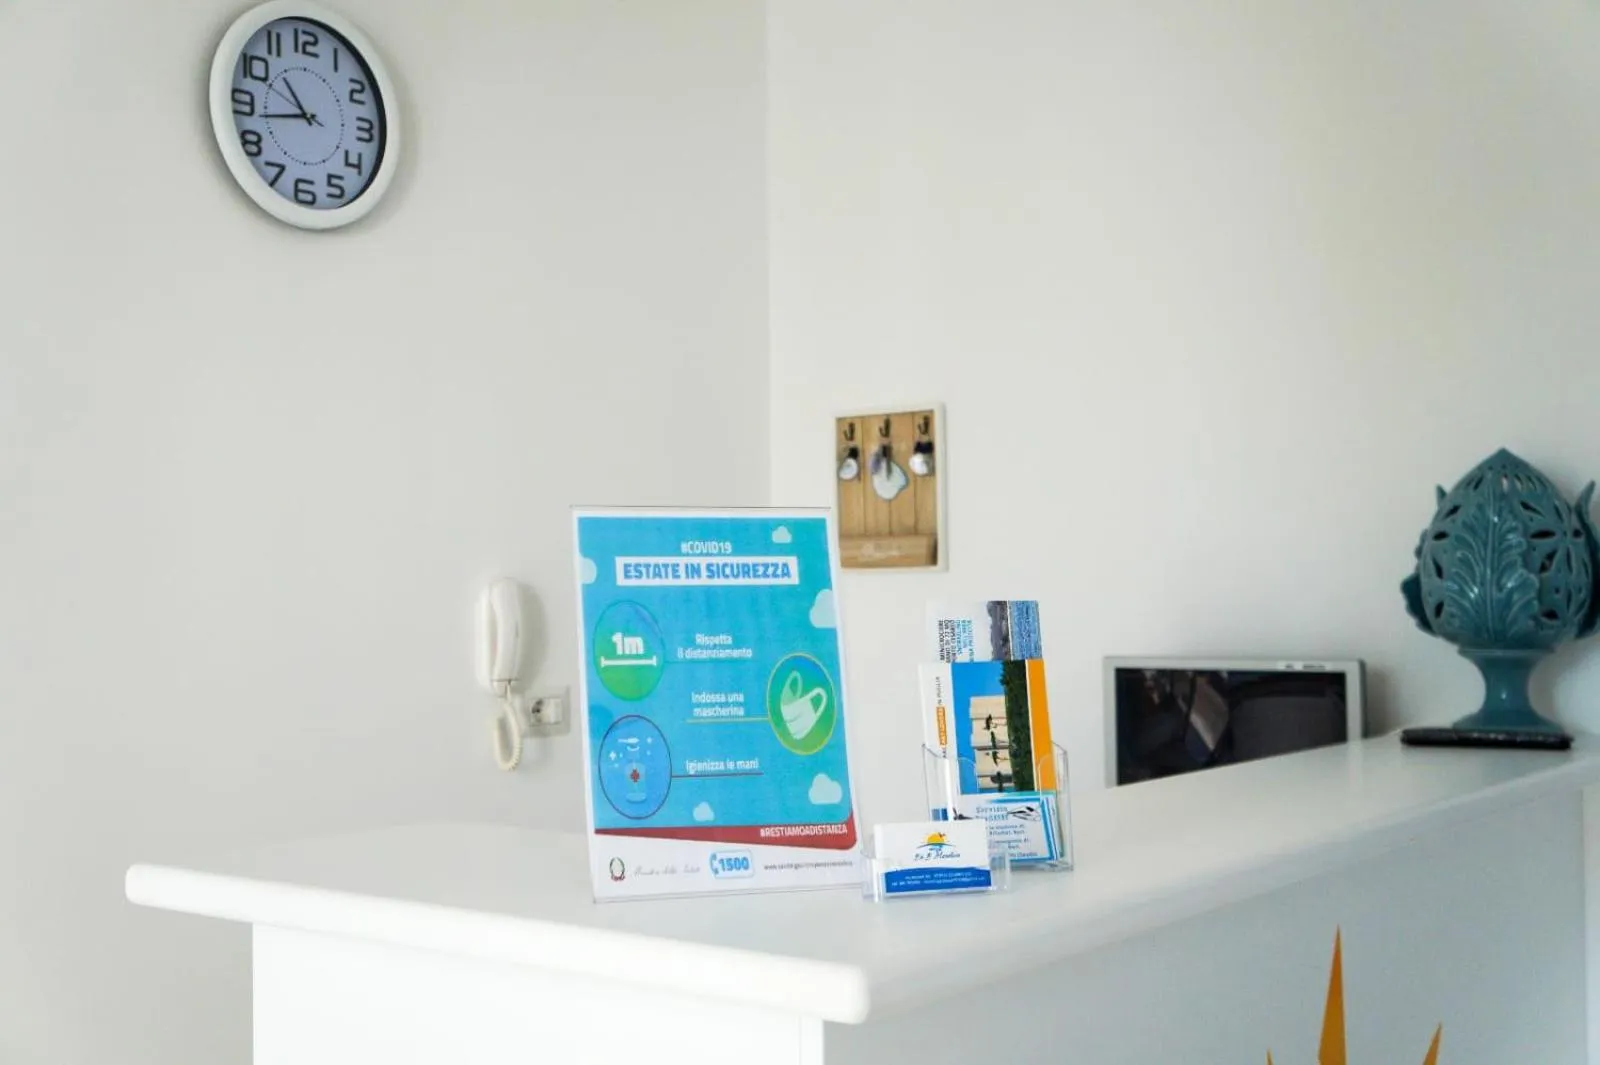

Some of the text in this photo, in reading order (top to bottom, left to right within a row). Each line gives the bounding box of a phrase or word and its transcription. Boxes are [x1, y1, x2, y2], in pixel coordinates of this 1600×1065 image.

[266, 29, 281, 58] 11
[294, 27, 319, 59] 12
[242, 52, 269, 81] 10
[333, 47, 339, 73] 1
[231, 88, 255, 117] 9
[348, 77, 366, 105] 2
[240, 129, 262, 157] 8
[355, 116, 374, 144] 3
[264, 161, 287, 187] 7
[344, 149, 363, 176] 4
[293, 178, 317, 206] 6
[326, 173, 346, 199] 5
[681, 541, 732, 554] #COVID19
[623, 562, 792, 580] ESTATE IN SICUREZZA
[611, 632, 644, 655] 1m
[695, 633, 733, 646] Rispetta
[685, 647, 753, 659] distanziamento
[691, 691, 745, 703] Indossa una
[693, 704, 745, 717] mascherina
[686, 757, 759, 775] Igienizza le mani
[718, 856, 750, 872] 1500
